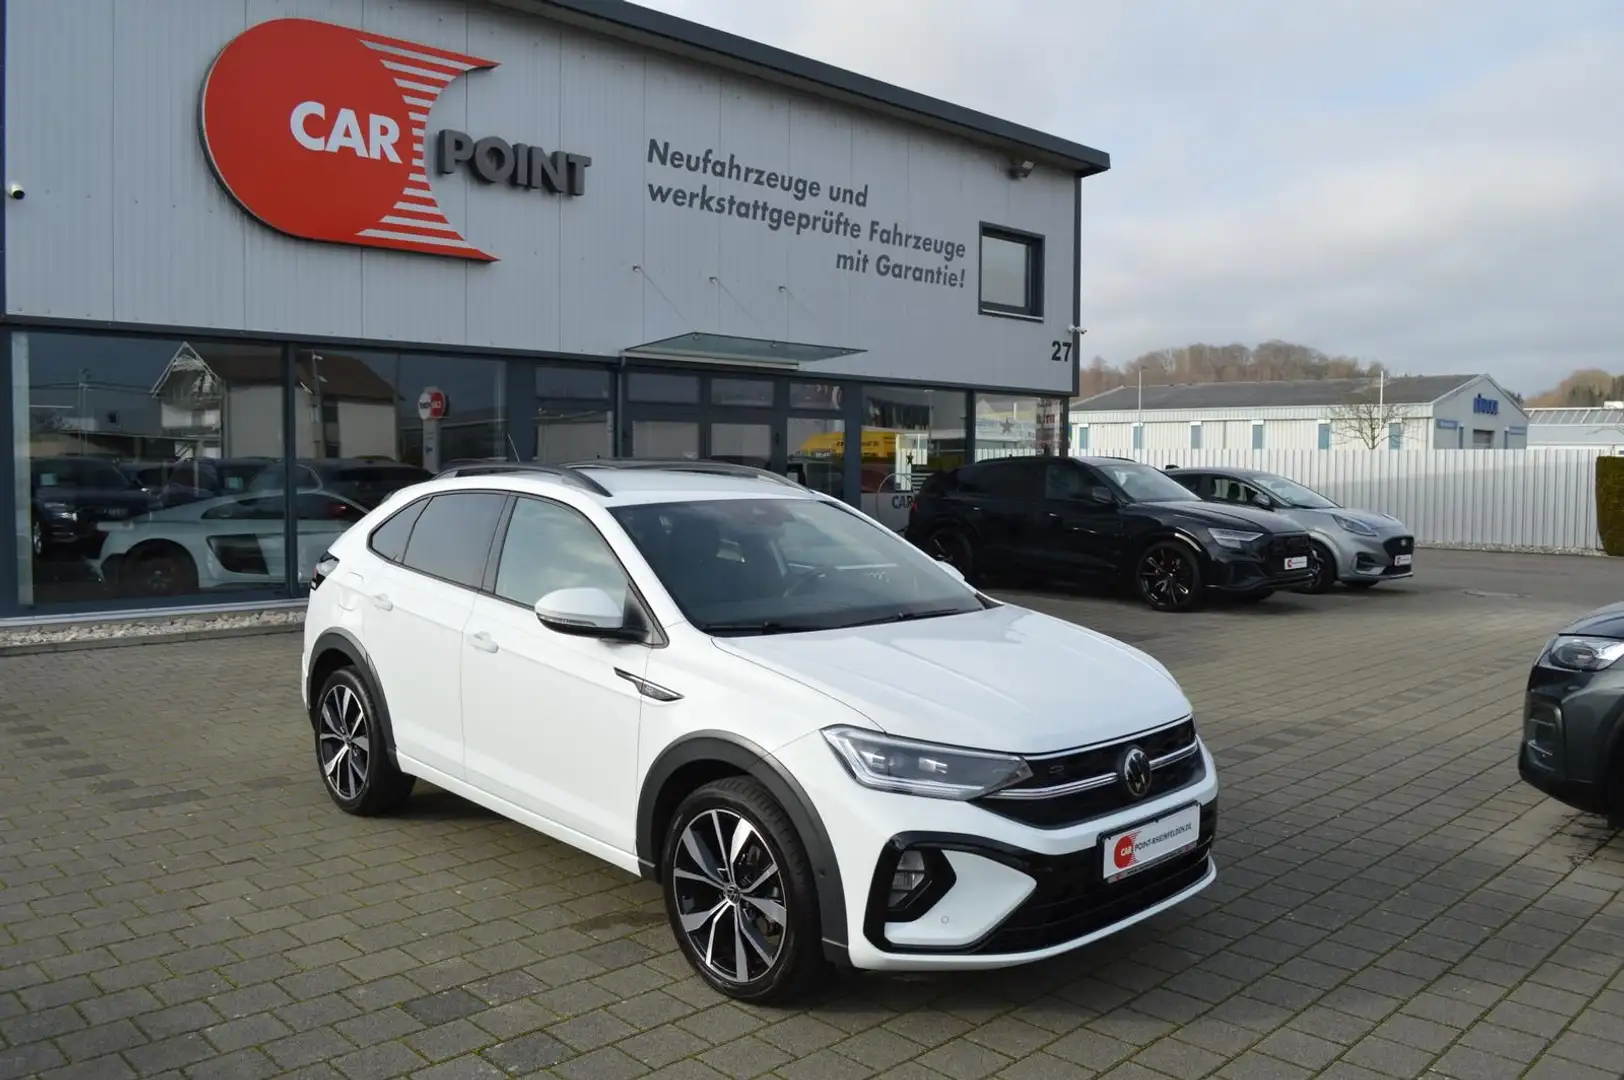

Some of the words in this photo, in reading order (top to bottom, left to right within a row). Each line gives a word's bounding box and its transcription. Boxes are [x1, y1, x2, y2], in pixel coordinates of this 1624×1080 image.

[289, 100, 403, 164] CAR
[437, 129, 592, 197] POINT
[647, 138, 822, 202] Neufahrzeuge
[829, 184, 869, 208] und
[647, 182, 862, 239] werkstattgeprüfte
[868, 220, 967, 260] Fahrzeuge
[836, 249, 870, 275] mit
[875, 254, 966, 289] Garantie!
[1051, 340, 1073, 363] 27
[1120, 845, 1133, 857] CAR
